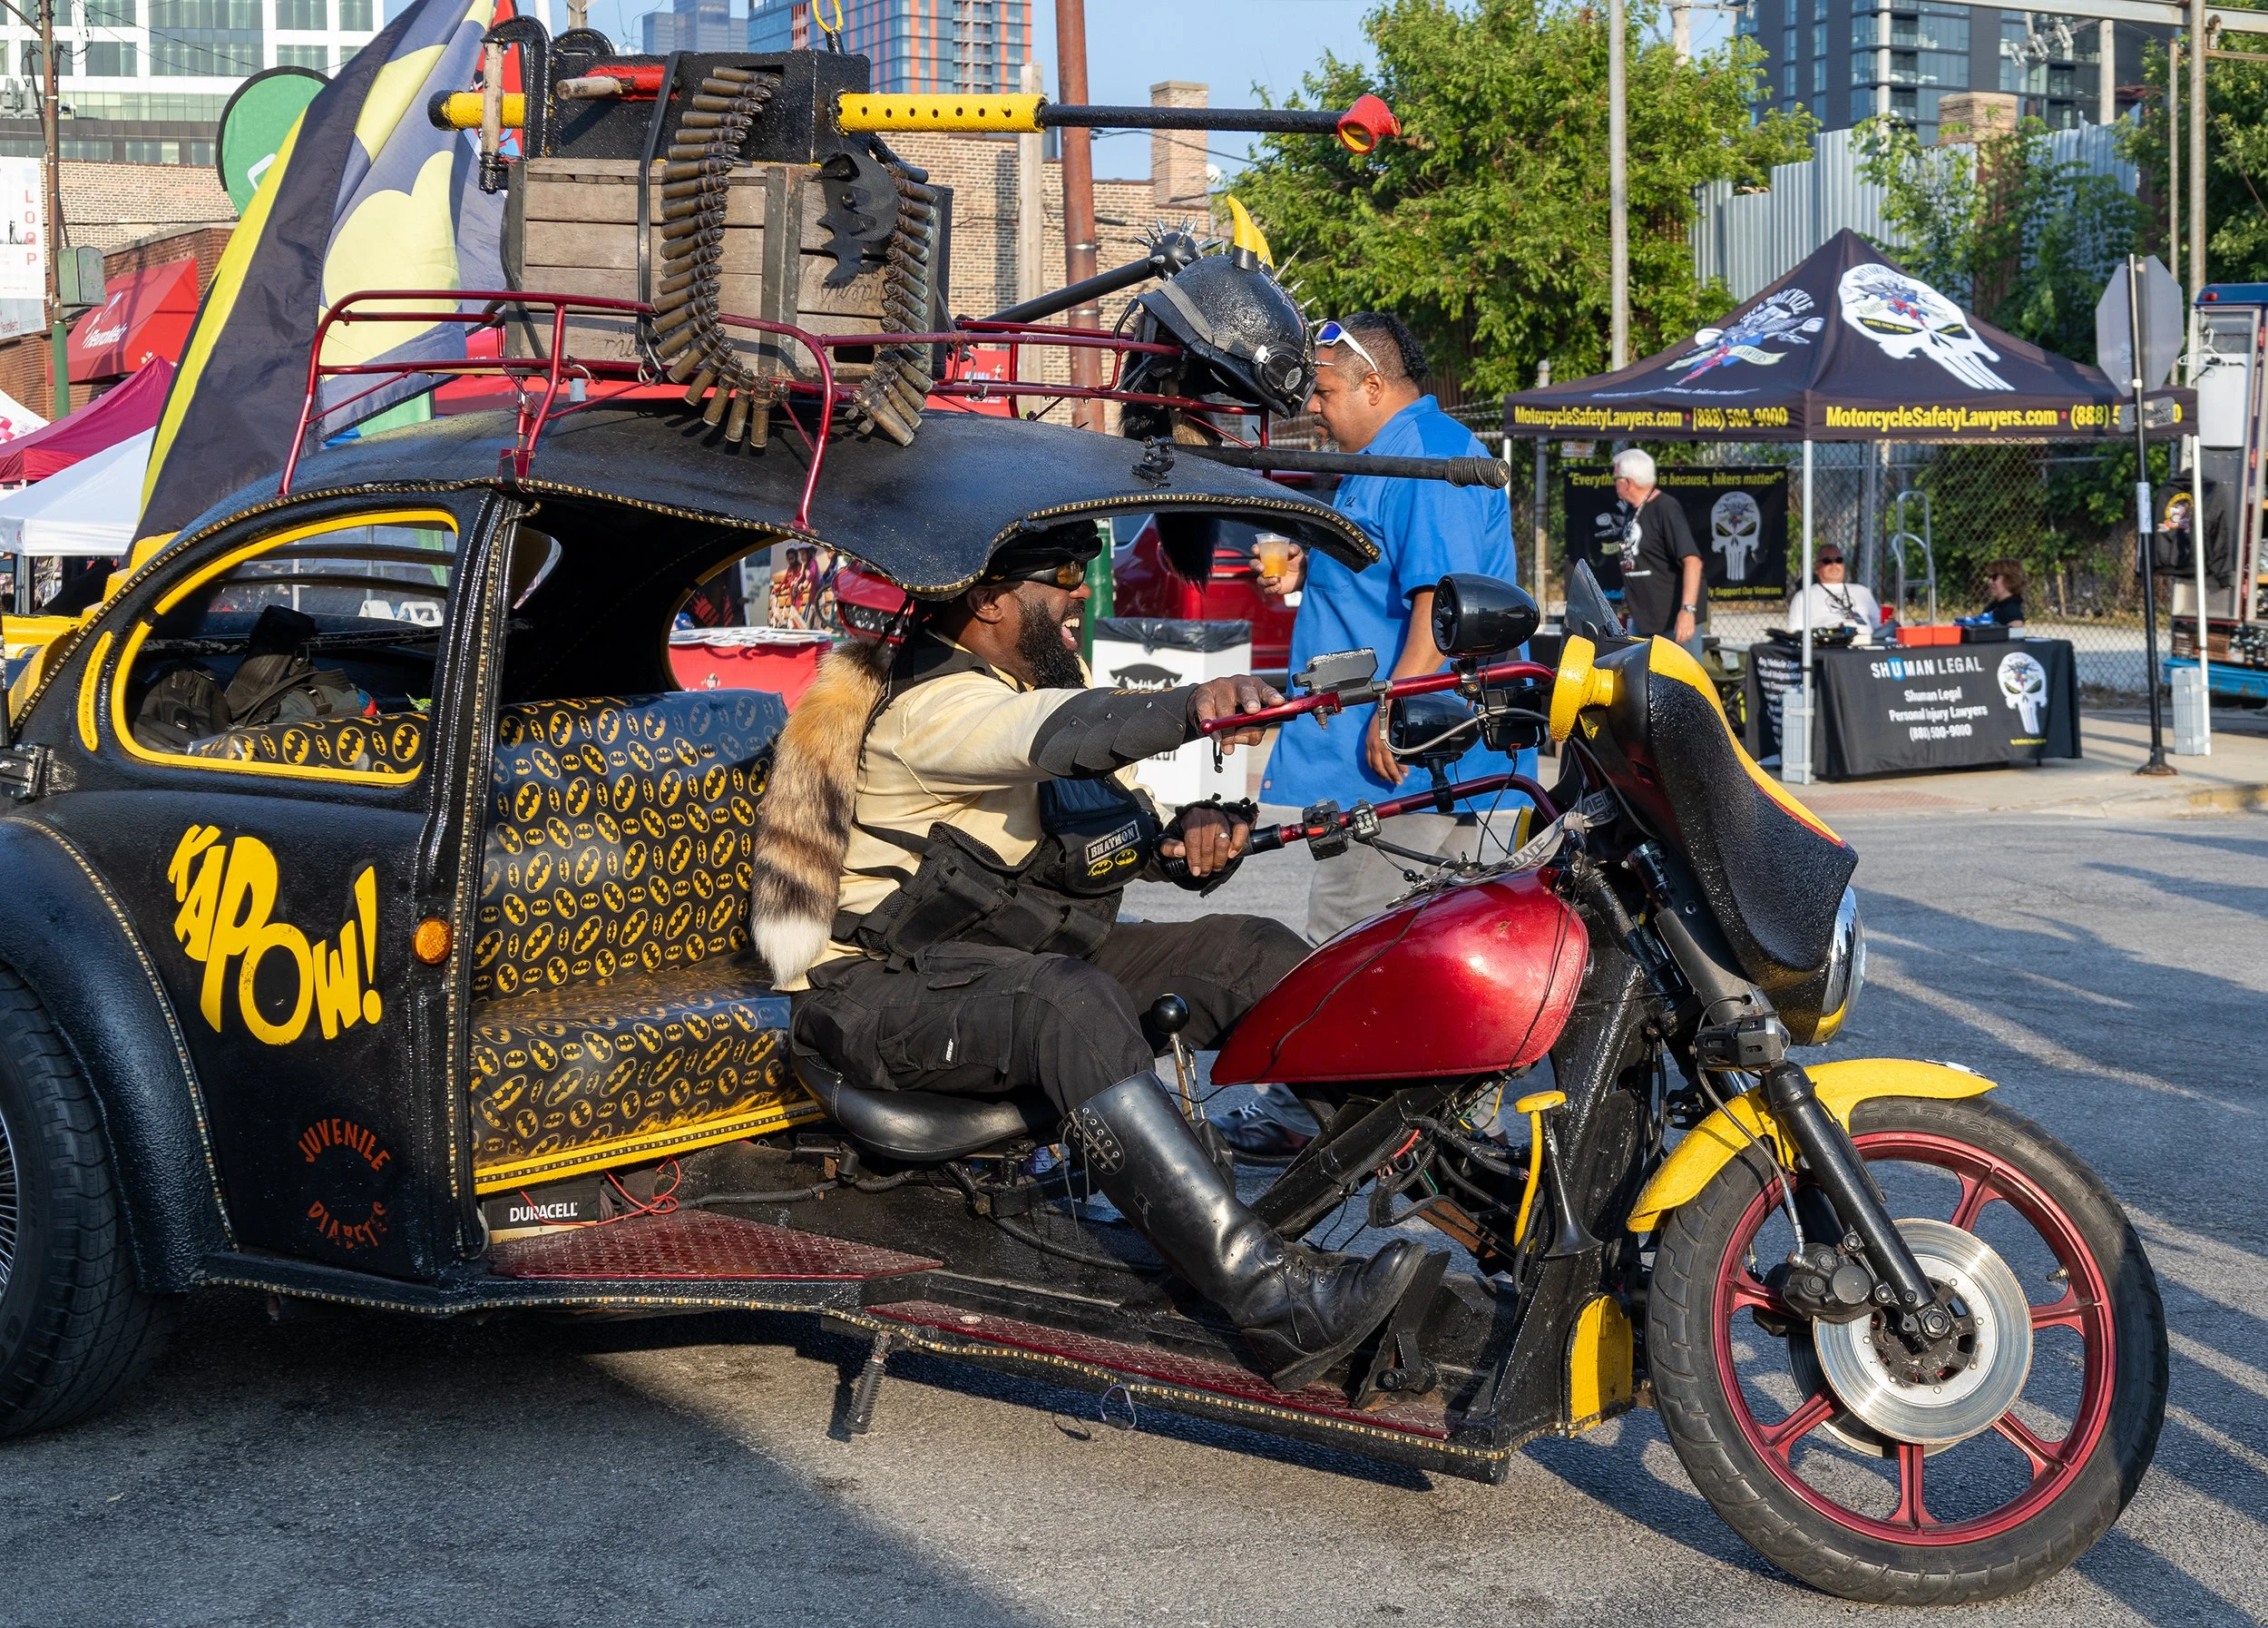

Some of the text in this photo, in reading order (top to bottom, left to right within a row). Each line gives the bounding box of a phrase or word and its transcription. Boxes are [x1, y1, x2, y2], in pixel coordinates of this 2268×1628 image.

[1514, 406, 1788, 431] MotorcycleSafetyLawyers.com (888) 500-9000
[1826, 405, 2058, 432] MotorcycleSafetyLawyers.com
[2070, 405, 2109, 430] (888)
[1659, 474, 1667, 485] is
[1669, 472, 1710, 487] because,
[1712, 472, 1741, 485] bikers
[1714, 585, 1744, 597] Support
[1755, 585, 1782, 595] Veterans
[1871, 655, 1982, 680] SHUMAN LEGAL
[1904, 686, 1962, 702] Shuman Legal
[1889, 708, 1925, 721] Personal
[1950, 705, 1988, 720] Lawyers
[1090, 827, 1136, 858] BHATMON
[168, 824, 382, 1045] KAPOW!
[298, 1118, 391, 1172] JUVENILE
[509, 1202, 579, 1222] DURACELL
